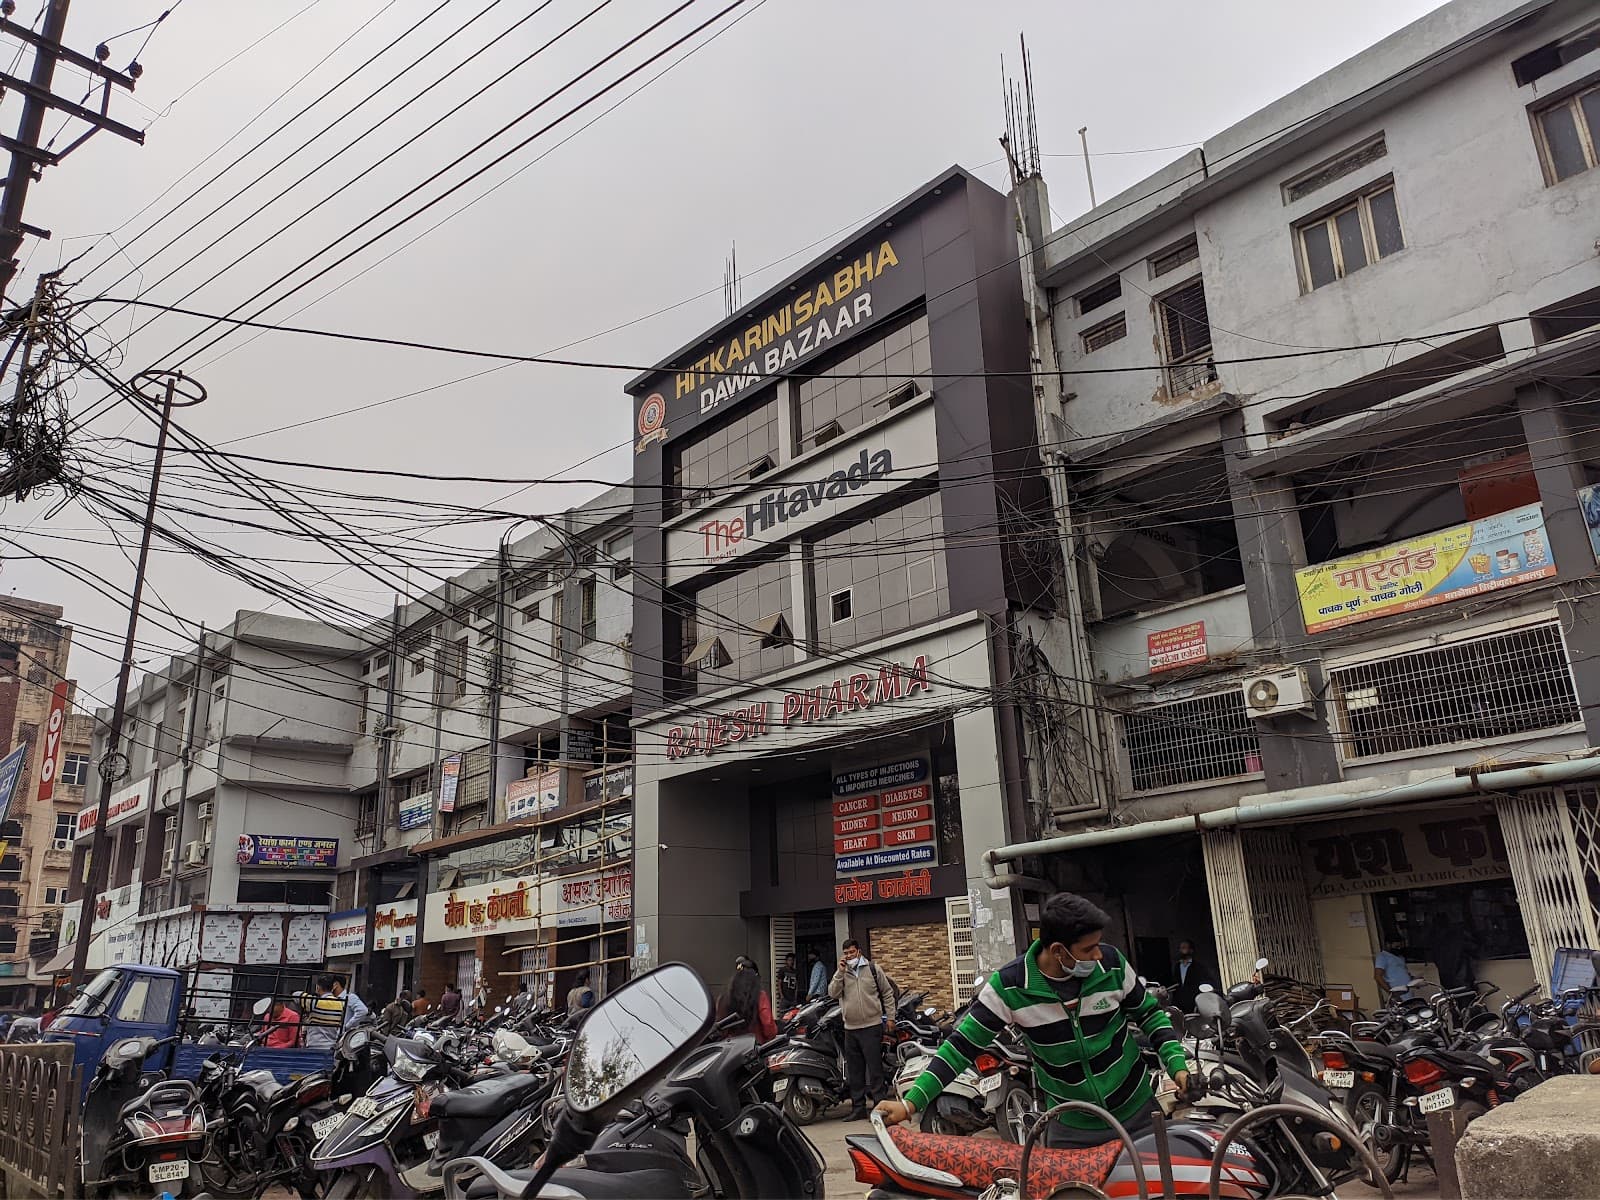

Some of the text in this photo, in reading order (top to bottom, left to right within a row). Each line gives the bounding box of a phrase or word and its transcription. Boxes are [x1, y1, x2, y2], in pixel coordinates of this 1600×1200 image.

[699, 291, 874, 414] DAWA BAZAAR
[699, 448, 894, 557] The Hitavada
[665, 702, 768, 760] RAJESH
[781, 655, 930, 729] PHARMA
[41, 708, 62, 782] OYO
[836, 760, 919, 785] ALL TYPES OF INJECTIONS
[846, 779, 877, 793] IMPORTED
[885, 788, 923, 804] DIABETES
[839, 799, 868, 813] CANCER
[892, 809, 919, 822] NEURO
[841, 818, 868, 831] KIDNEY
[897, 829, 916, 841] SKIN
[843, 838, 868, 850] HEART
[837, 849, 930, 869] Available At Discounted Rates
[835, 876, 873, 904] राजेश
[783, 975, 797, 990] 43
